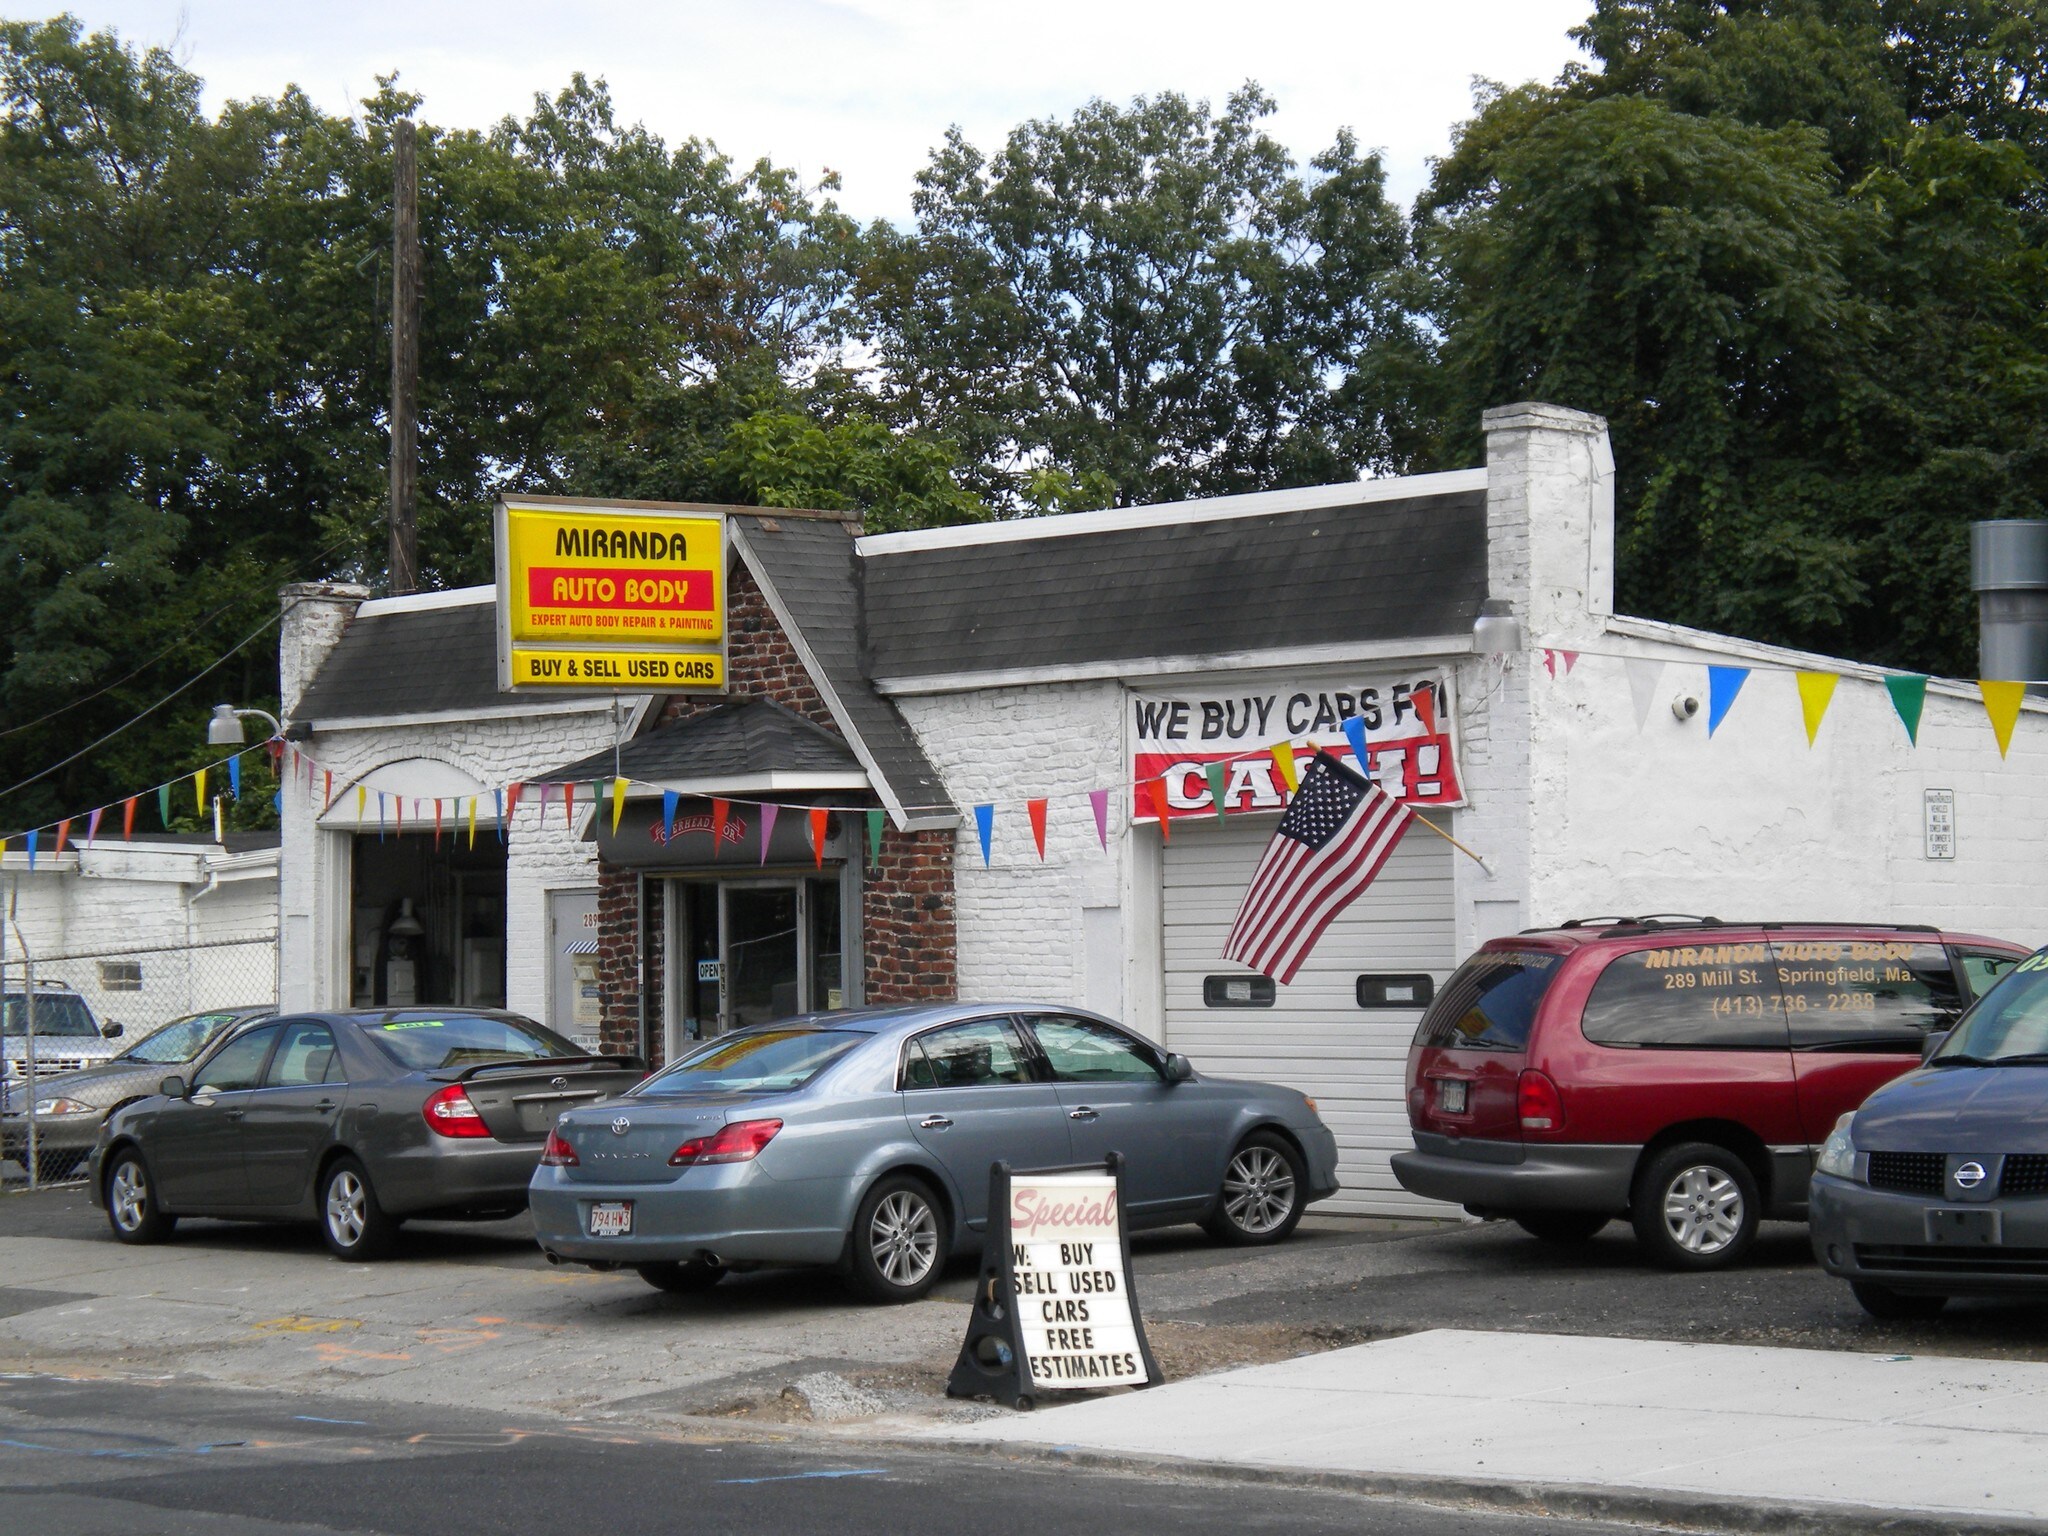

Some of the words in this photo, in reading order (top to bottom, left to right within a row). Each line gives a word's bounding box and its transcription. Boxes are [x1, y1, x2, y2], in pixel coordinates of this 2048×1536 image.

[556, 527, 687, 561] MIRANDA
[552, 576, 616, 602] AUTO
[624, 578, 689, 604] BODY
[531, 614, 567, 626] EXPERT
[569, 615, 593, 627] AUTO
[596, 615, 620, 627] BODY
[622, 616, 656, 628] REPAIR
[659, 617, 666, 628] &
[669, 617, 713, 630] PAINTING
[531, 659, 563, 676] BUY
[567, 659, 579, 676] &
[583, 659, 621, 677] SELL
[628, 660, 669, 678] USED
[674, 661, 714, 679] CARS
[1136, 700, 1191, 740] WE
[1200, 694, 1277, 740] BUY
[1286, 687, 1383, 736] CARS
[660, 817, 710, 840] OERHEAD
[583, 914, 598, 928] 289
[1646, 946, 1765, 969] MIRANDA
[1777, 943, 1843, 962] AUTO
[1851, 943, 1913, 962] BODY
[700, 964, 719, 978] OPEN
[1664, 972, 1696, 990] 289
[1702, 970, 1733, 986] Mill
[1739, 969, 1763, 985] St.
[1778, 965, 1881, 986] Springfield,
[1885, 967, 1917, 983] Ma.
[1711, 996, 1764, 1020] (413)
[1770, 994, 1808, 1013] 736
[1828, 993, 1875, 1012] 2288
[592, 1211, 610, 1227] 794
[1010, 1189, 1117, 1237] Special
[1060, 1243, 1094, 1266] BUY
[1014, 1272, 1058, 1295] SELL
[1069, 1271, 1116, 1293] USED
[1042, 1300, 1090, 1323] CARS
[1046, 1328, 1095, 1350] FREE
[1030, 1353, 1137, 1379] ESTIMATES
